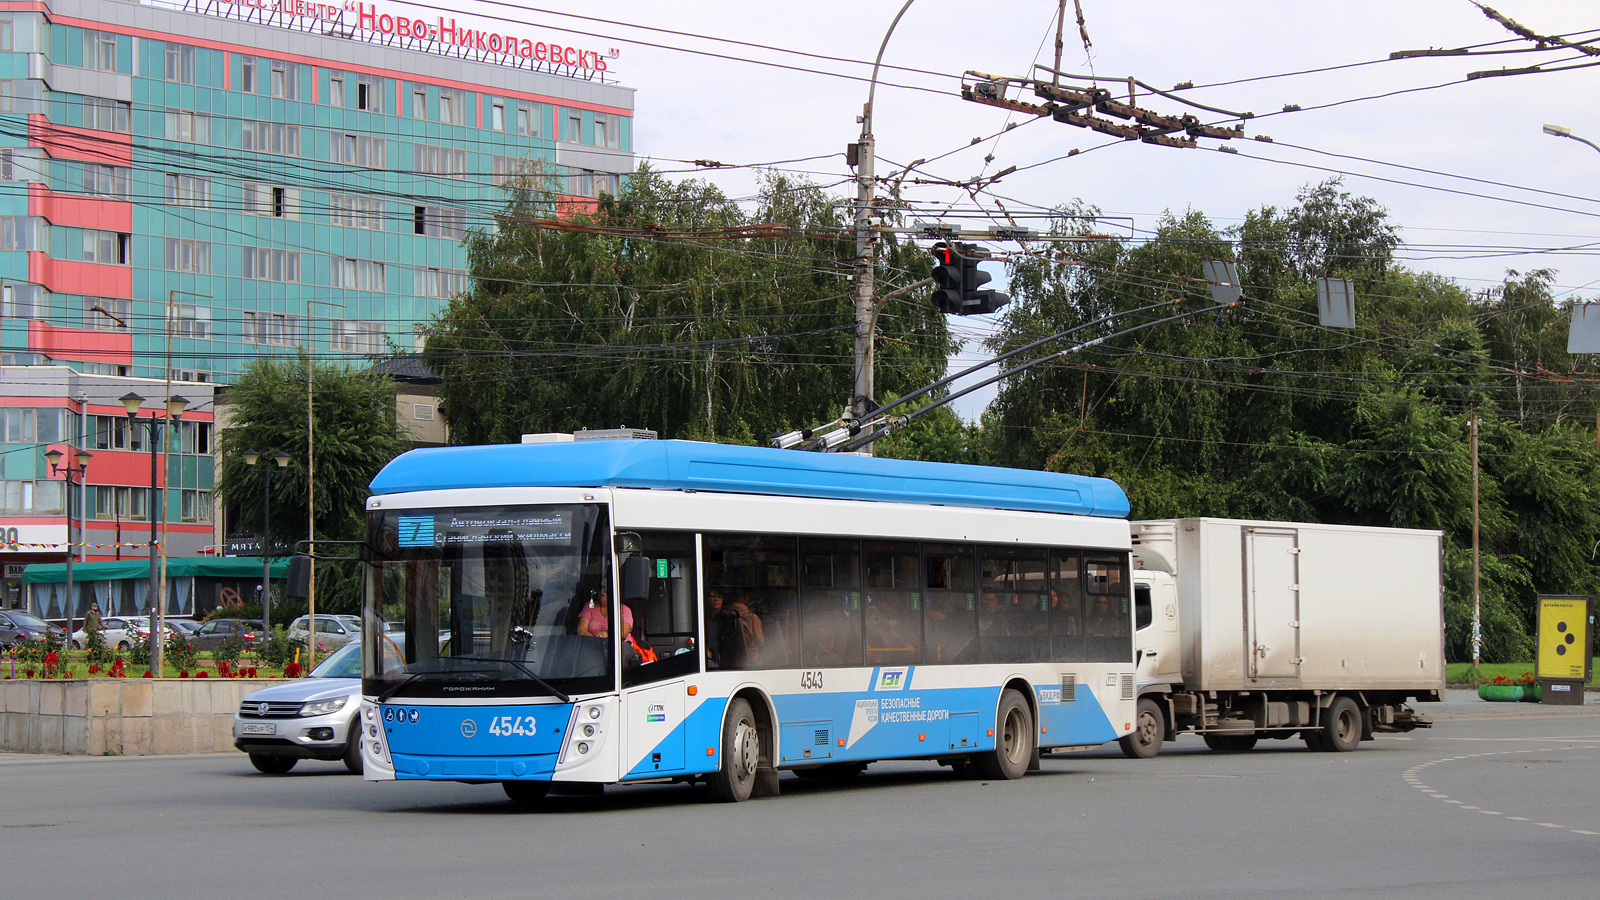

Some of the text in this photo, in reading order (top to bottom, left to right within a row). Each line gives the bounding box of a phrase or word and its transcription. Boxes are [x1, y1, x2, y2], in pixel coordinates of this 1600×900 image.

[434, 530, 513, 543] Станиславский
[231, 542, 261, 551] МЯТА
[801, 671, 823, 689] 4543
[881, 697, 920, 709] БЕЗОПАСНЫЕ
[881, 709, 949, 722] КАЧЕСТВЕННЫЕ ДОРОГИ
[489, 716, 537, 736] 4543
